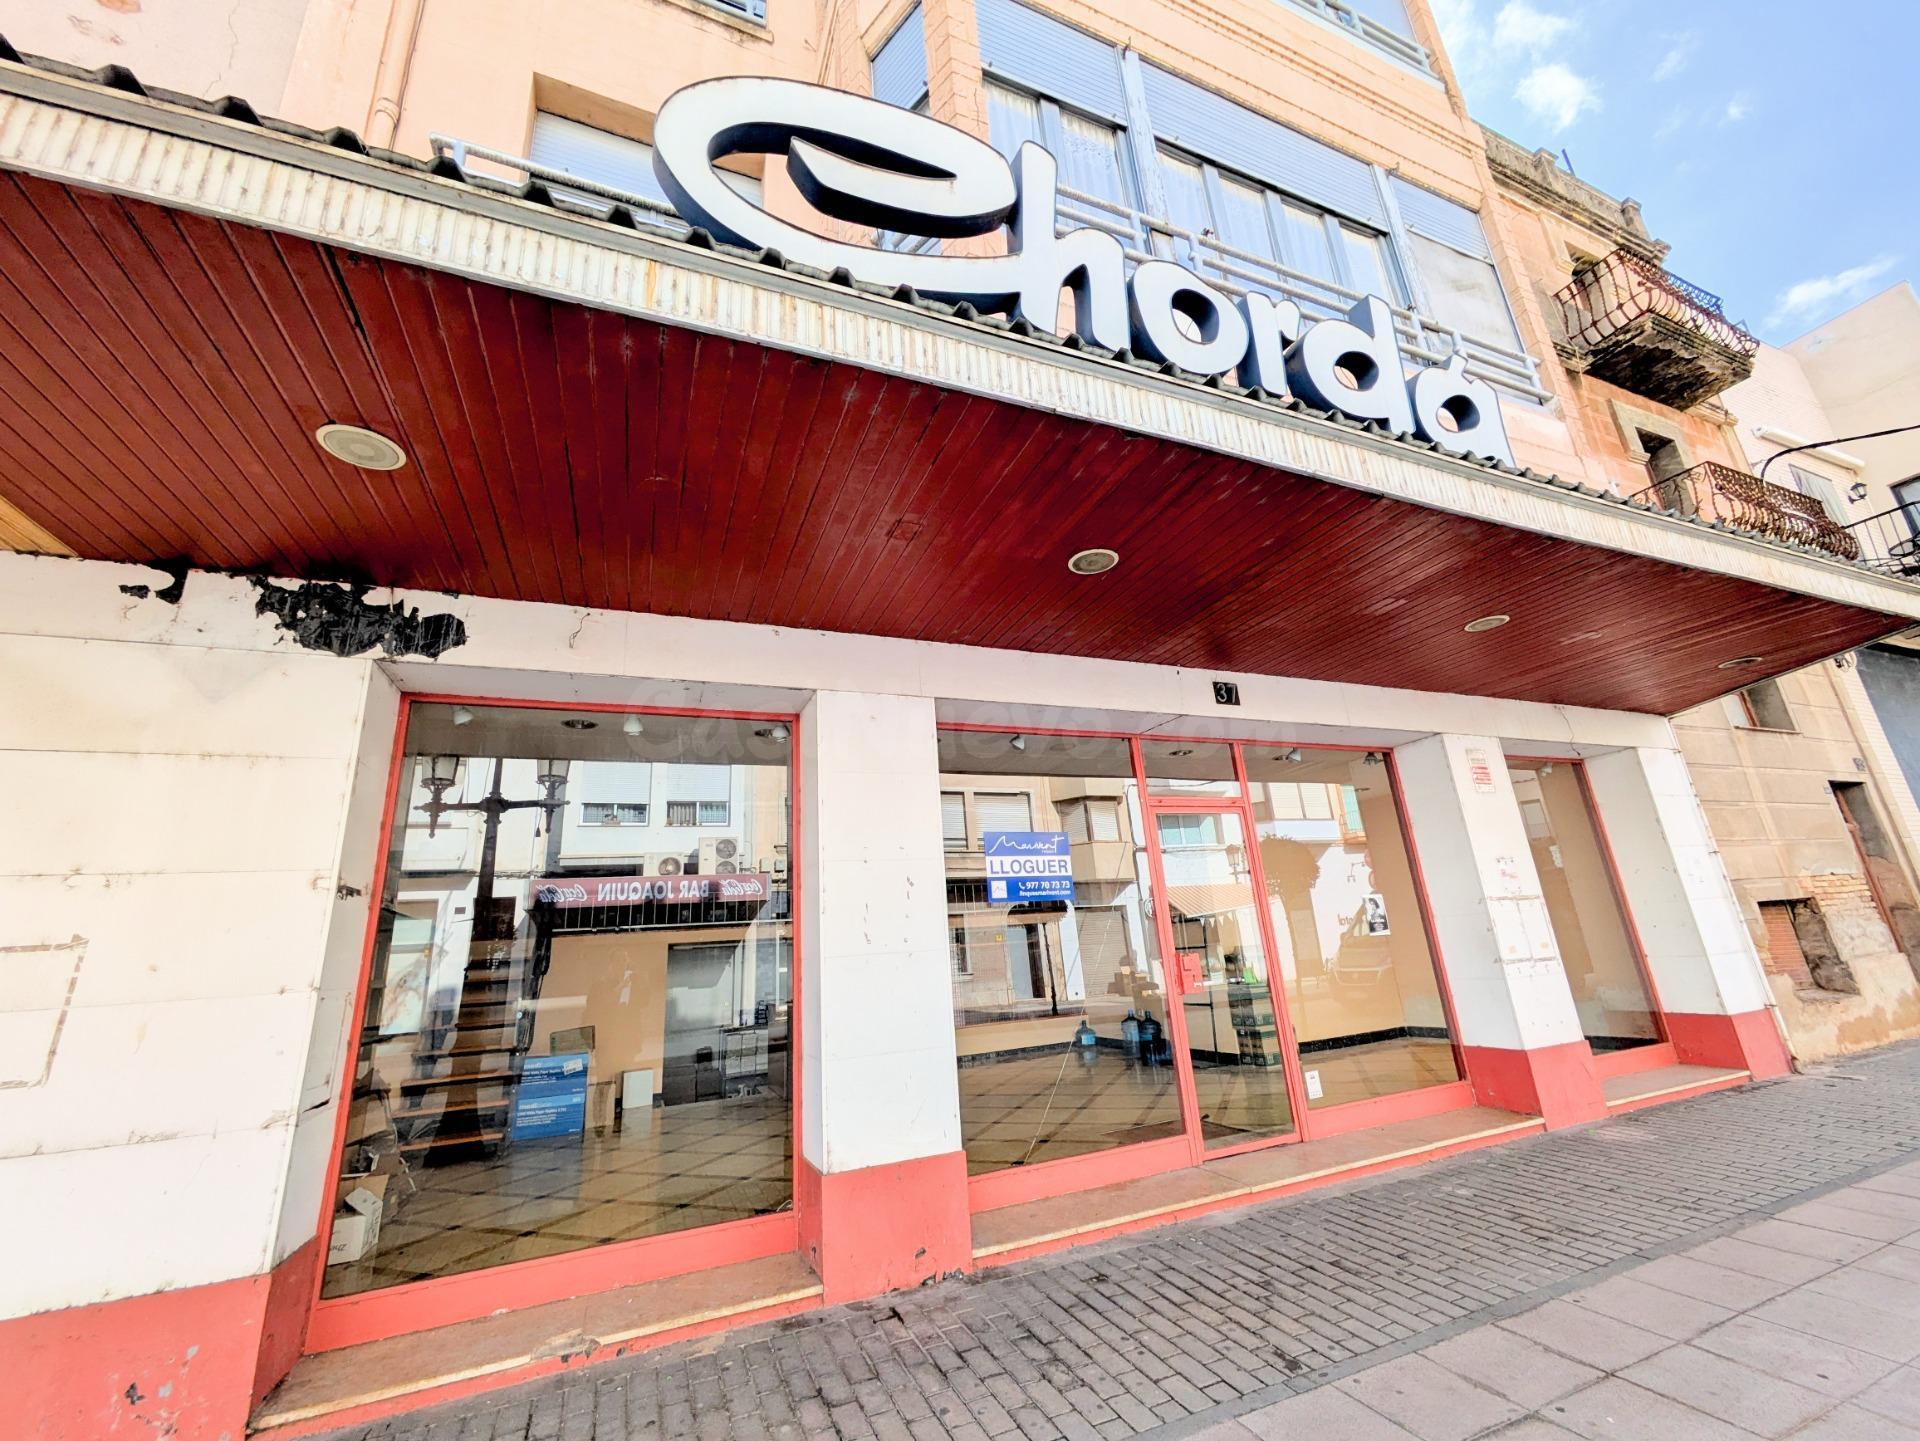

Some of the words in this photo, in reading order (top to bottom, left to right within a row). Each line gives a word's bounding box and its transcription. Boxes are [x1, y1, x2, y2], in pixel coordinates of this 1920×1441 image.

[1216, 682, 1237, 704] 37
[990, 859, 1069, 875] LLOGUER
[1026, 881, 1039, 889] 977
[1041, 881, 1050, 889] 70
[1051, 881, 1060, 889] 73
[1061, 880, 1070, 888] 73
